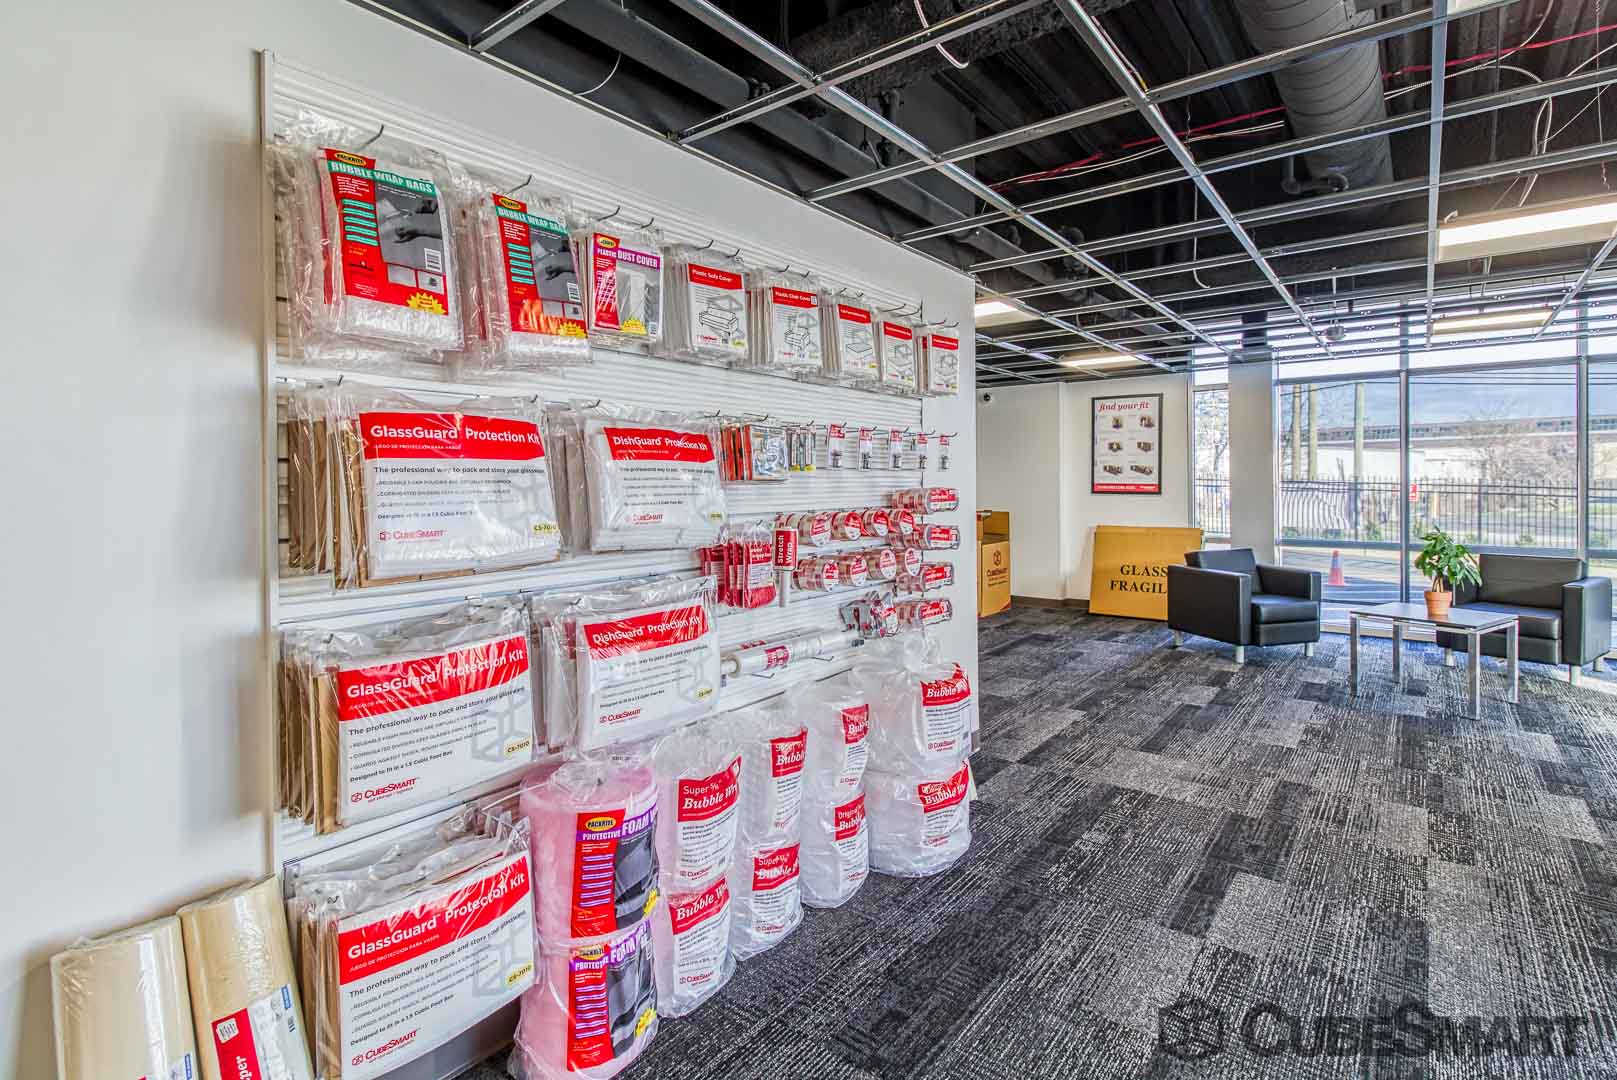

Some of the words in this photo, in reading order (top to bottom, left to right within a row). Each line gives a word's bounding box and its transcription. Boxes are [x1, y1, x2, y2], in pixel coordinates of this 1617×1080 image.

[330, 162, 375, 179] BUBBLE
[374, 171, 403, 186] WRAP
[405, 181, 432, 193] BAGS
[498, 208, 527, 222] BUBBLE
[527, 215, 549, 229] WRAP
[597, 248, 617, 257] PLASTIC
[617, 249, 636, 262] DUST
[636, 254, 658, 268] COVER
[692, 268, 707, 279] Plastic
[708, 272, 719, 281] Sofa
[719, 275, 734, 283] Cover
[1098, 401, 1116, 412] find
[1118, 402, 1138, 411] your
[1139, 401, 1150, 409] fit
[370, 425, 459, 439] GlassGuard
[466, 427, 524, 444] Protection
[613, 436, 661, 447] DishGuard
[665, 438, 698, 449] Protection
[391, 466, 435, 474] professional
[462, 466, 477, 474] pack
[1120, 565, 1168, 577] GLASS
[1109, 580, 1168, 593] FRAGIL
[592, 627, 644, 645] DishGuard
[648, 619, 688, 635] Protection
[689, 615, 700, 626] Kit
[347, 671, 437, 698] GlassGuard
[444, 656, 507, 679] Protection
[509, 648, 524, 662] Kit
[926, 685, 956, 698] Bubble
[349, 728, 364, 737] The
[366, 716, 412, 735] professional
[413, 713, 428, 723] way
[429, 709, 438, 718] to
[439, 706, 454, 717] pack
[456, 702, 468, 711] and
[507, 740, 530, 753] CS-7010
[351, 771, 378, 782] Designed
[413, 756, 429, 765] Cubic
[430, 752, 442, 760] Foot
[364, 777, 417, 799] CUBESMART
[682, 792, 724, 810] Bubble
[725, 784, 737, 799] Wr
[683, 785, 709, 797] Super
[924, 788, 957, 804] Bubble
[838, 807, 858, 819] Original
[582, 830, 621, 841] PROTECTIVE
[622, 815, 649, 836] FOAM
[348, 916, 437, 960] GlassGuard
[445, 882, 508, 924] Protecton
[510, 873, 525, 889] Kit
[675, 893, 714, 921] Bubble
[610, 939, 637, 963] FOAM
[350, 988, 365, 998] The
[366, 968, 413, 993] professional
[414, 961, 429, 971] way
[440, 951, 456, 961] pack
[456, 943, 469, 952] and
[470, 935, 486, 945] store
[350, 1029, 379, 1046] Designed
[430, 999, 443, 1009] Foot
[365, 1030, 418, 1059] CUBESMART
